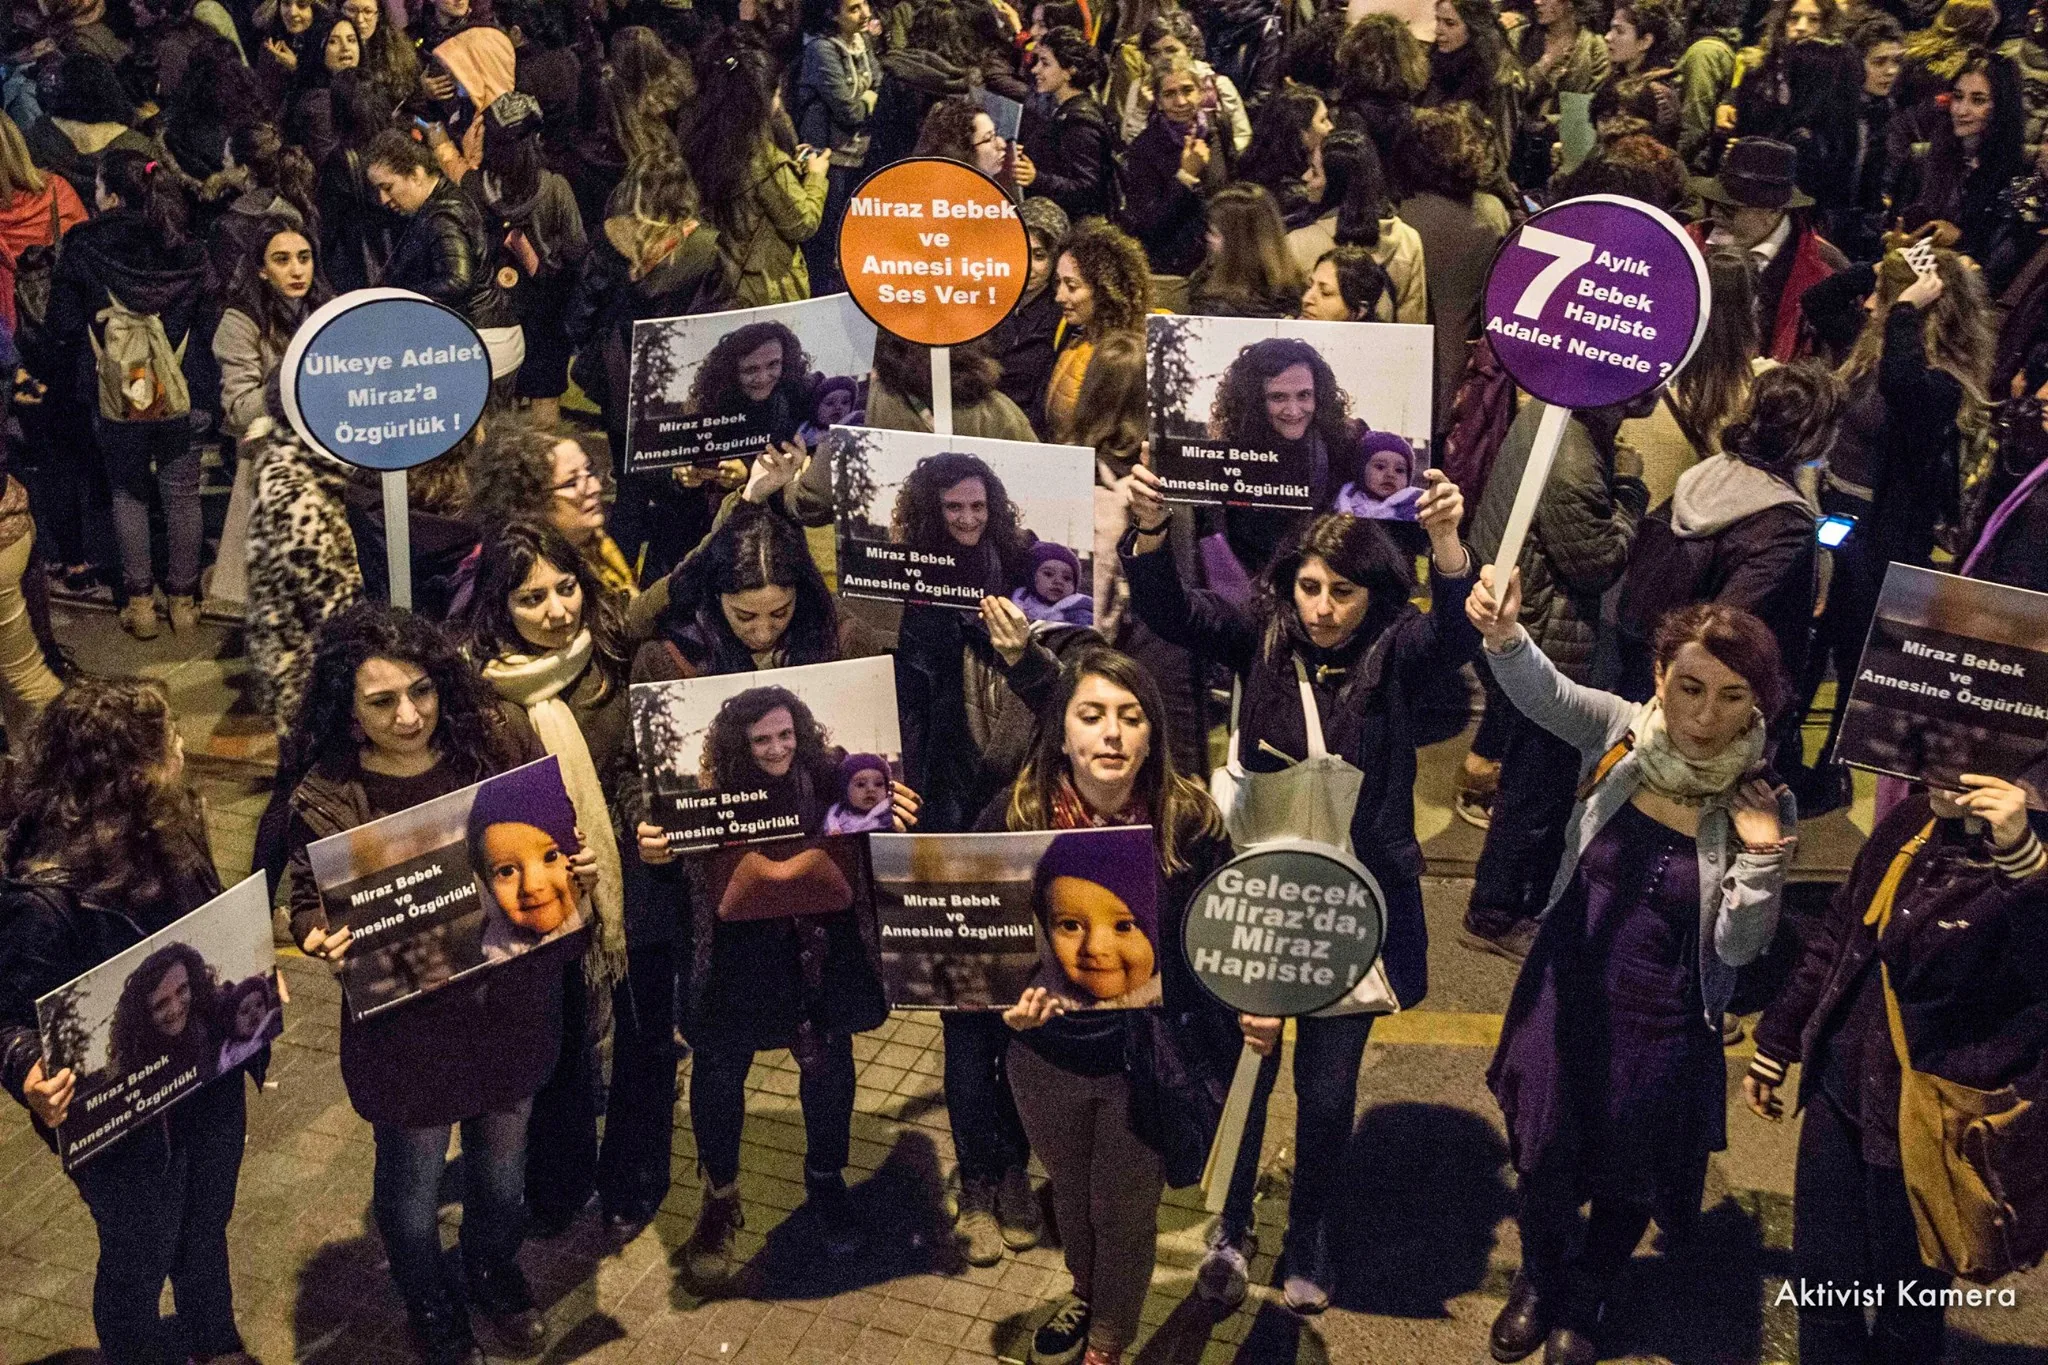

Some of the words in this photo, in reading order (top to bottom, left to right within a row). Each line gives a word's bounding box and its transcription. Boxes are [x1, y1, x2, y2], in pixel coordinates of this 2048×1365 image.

[850, 197, 924, 218] Miraz
[932, 199, 1018, 219] Bebek
[919, 232, 949, 247] ve
[862, 255, 952, 276] Annesi
[962, 257, 1010, 281] için
[1512, 225, 1596, 320] 7
[1595, 251, 1652, 277] Aylık
[878, 285, 926, 304] Ses
[934, 285, 980, 304] Ver
[988, 287, 996, 304] !
[1577, 278, 1654, 312] Bebek
[1564, 302, 1657, 340] Hapiste
[1486, 316, 1562, 350] Adalet
[1567, 338, 1651, 373] Nerede
[1658, 362, 1672, 377] ?
[305, 352, 392, 375] Ülkeye
[401, 343, 482, 367] Adalet
[335, 416, 446, 444] Özgürlük
[454, 413, 460, 430] !
[659, 421, 698, 432] Miraz
[703, 413, 746, 427] Bebek
[634, 446, 700, 460] Annesine
[705, 434, 771, 451] Özgürlük!
[697, 432, 712, 440] ve
[1182, 446, 1224, 460] Miraz
[1229, 448, 1278, 462] Bebek
[1223, 467, 1242, 477] ve
[1159, 477, 1229, 492] Annesine
[1234, 479, 1309, 497] Özgürlük!
[866, 547, 905, 561] Miraz
[910, 551, 955, 566] Bebek
[905, 568, 921, 577] ve
[844, 574, 910, 591] Annesine
[915, 580, 984, 598] Özgürlük!
[1902, 640, 1957, 663] Miraz
[1962, 653, 2026, 677] Bebek
[1859, 669, 1951, 699] Annesine
[1950, 671, 1972, 685] ve
[676, 797, 717, 810] Miraz
[721, 789, 768, 804] Bebek
[717, 809, 734, 820] ve
[665, 825, 724, 840] nnesine
[729, 814, 799, 833] Özgürlük!
[351, 884, 393, 907] Miraz
[396, 864, 443, 889] Bebek
[1217, 868, 1369, 908] Gelecek
[395, 893, 413, 907] ve
[408, 882, 477, 918] Özgürlük!
[903, 894, 946, 907] Miraz
[951, 894, 1001, 907] Bebek
[946, 913, 965, 922] ve
[882, 925, 953, 937] Annesine
[958, 924, 1033, 940] Özgürlük!
[1232, 925, 1332, 959] Miraz
[1194, 947, 1335, 985] Hapiste
[1346, 964, 1358, 988] !
[87, 1083, 124, 1111] Miraz
[128, 1055, 170, 1086] Bebek
[125, 1088, 141, 1103] ve
[69, 1109, 132, 1154] Annesine
[136, 1066, 198, 1111] Özgürlük!
